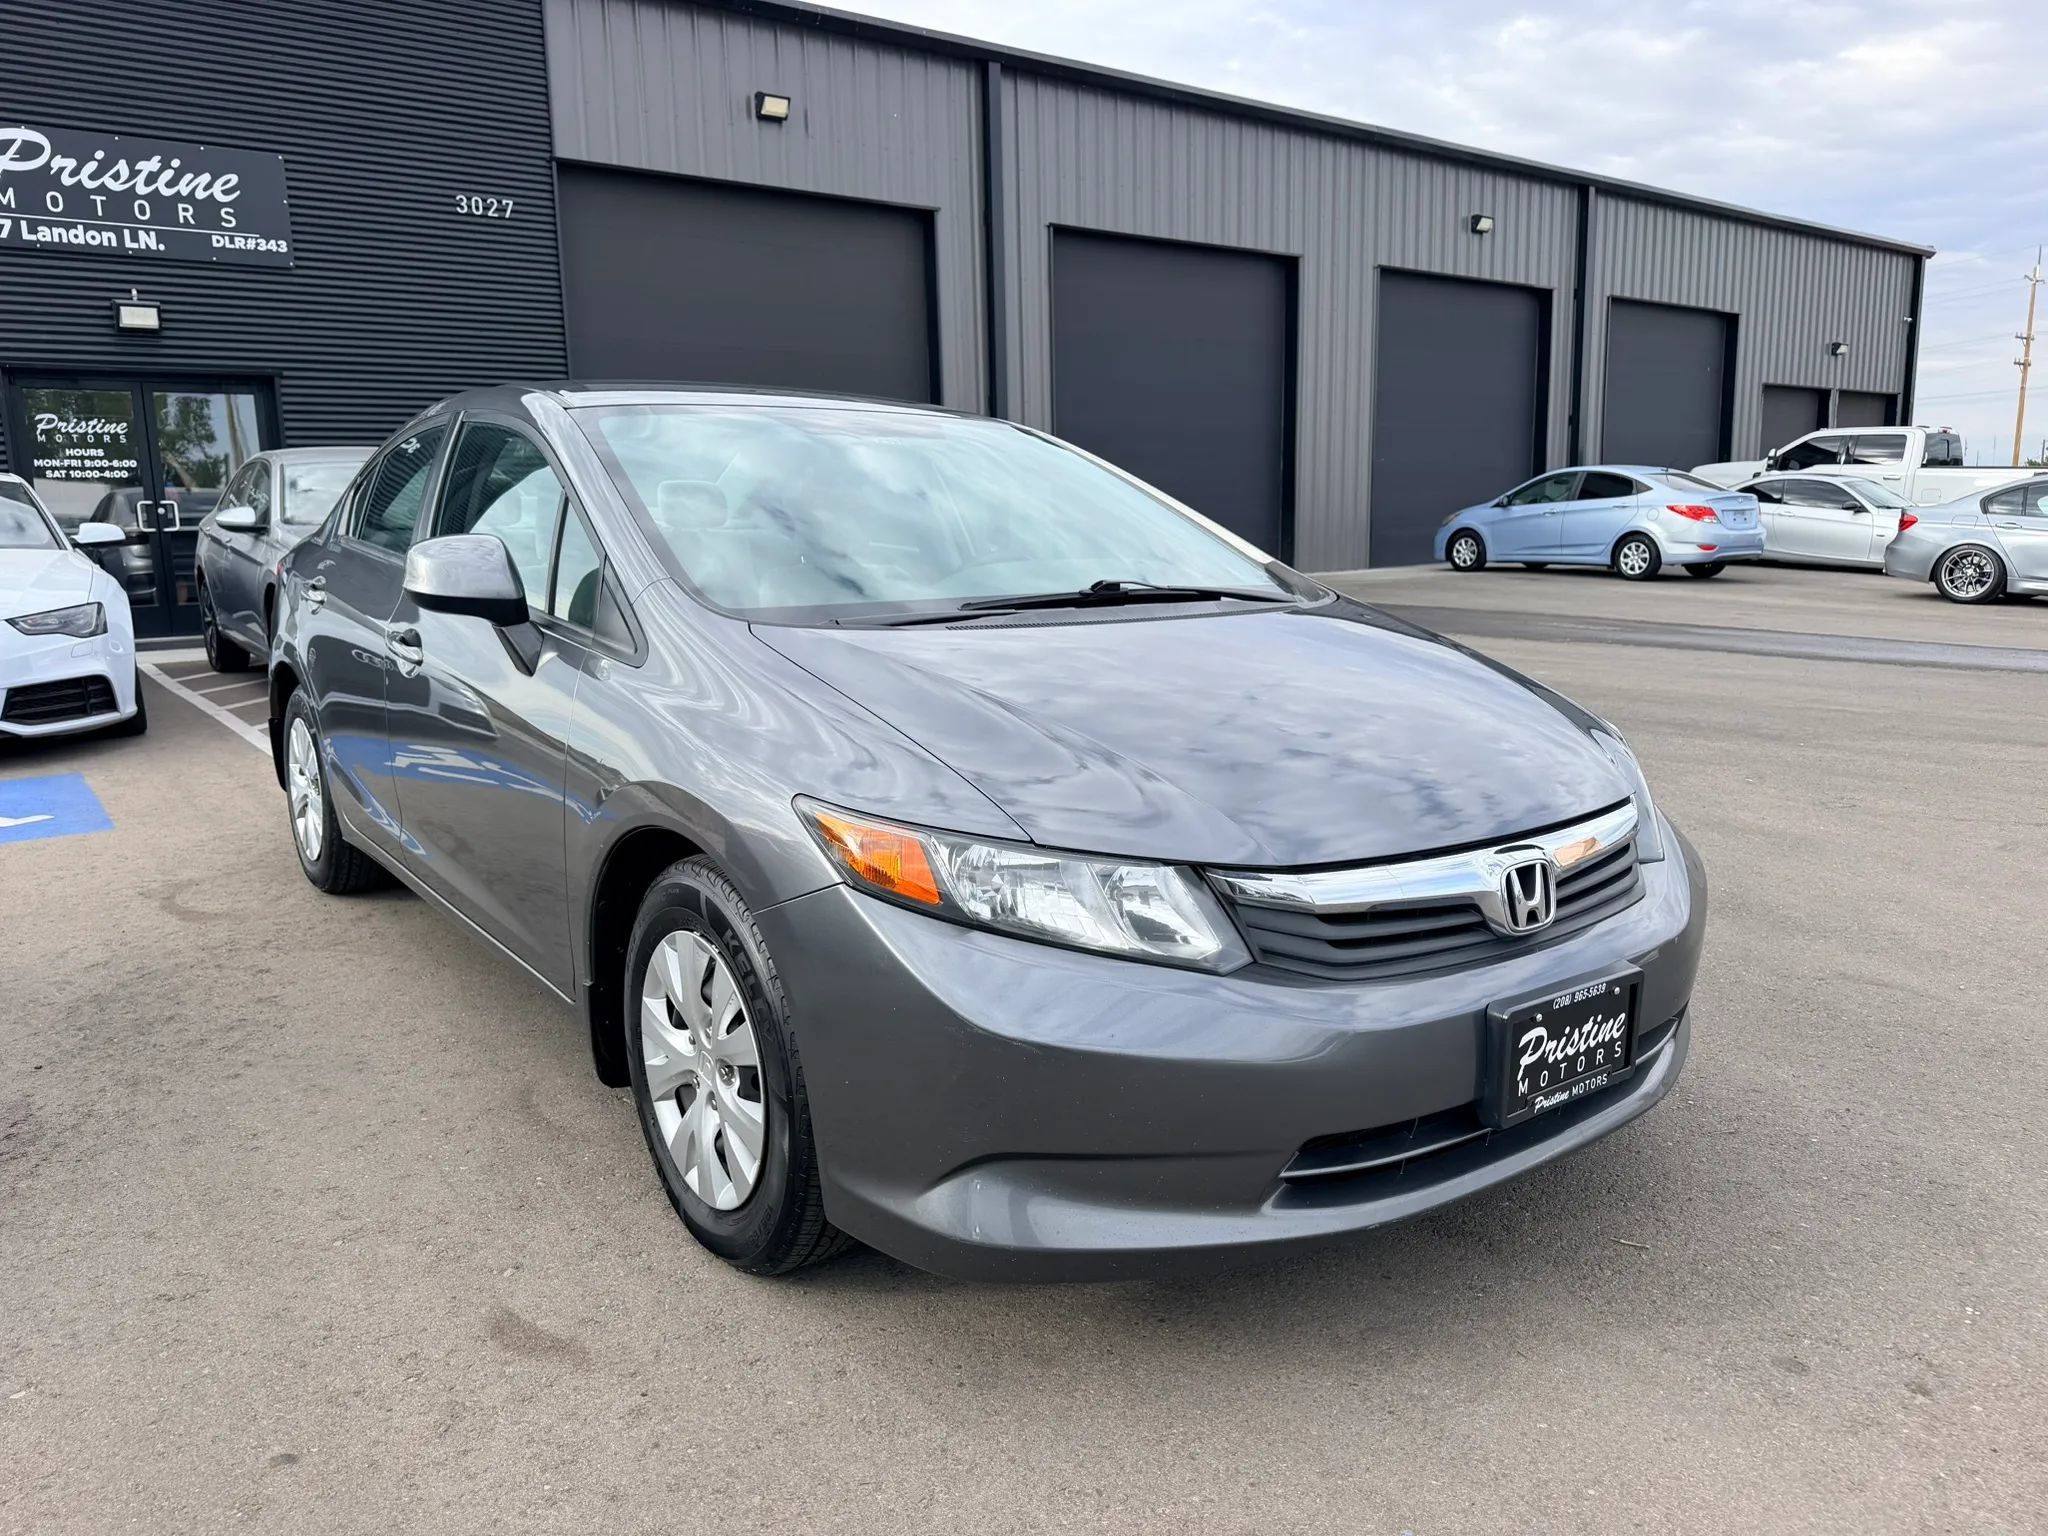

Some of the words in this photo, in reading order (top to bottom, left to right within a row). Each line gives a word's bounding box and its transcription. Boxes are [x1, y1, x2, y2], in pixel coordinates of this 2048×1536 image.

[0, 127, 241, 203] Pristine
[0, 186, 237, 228] MOTORS
[456, 194, 514, 219] 3027
[20, 219, 118, 247] Landon
[123, 228, 165, 251] LN.
[211, 235, 288, 253] DLR#343
[34, 413, 128, 436] Pristine
[37, 433, 127, 443] MOTORS
[33, 458, 82, 468] MON-FRI
[83, 459, 138, 468] 9:00-6:00
[65, 448, 105, 457] HOURS
[45, 469, 67, 478] SAT
[69, 469, 129, 479] 10:00-4:00
[1553, 993, 1572, 1010] (208)
[1517, 1012, 1626, 1081] Pristine
[1518, 1041, 1622, 1097] MOTORS
[1534, 1089, 1570, 1114] Pristine
[1571, 1073, 1608, 1097] MOTORS
